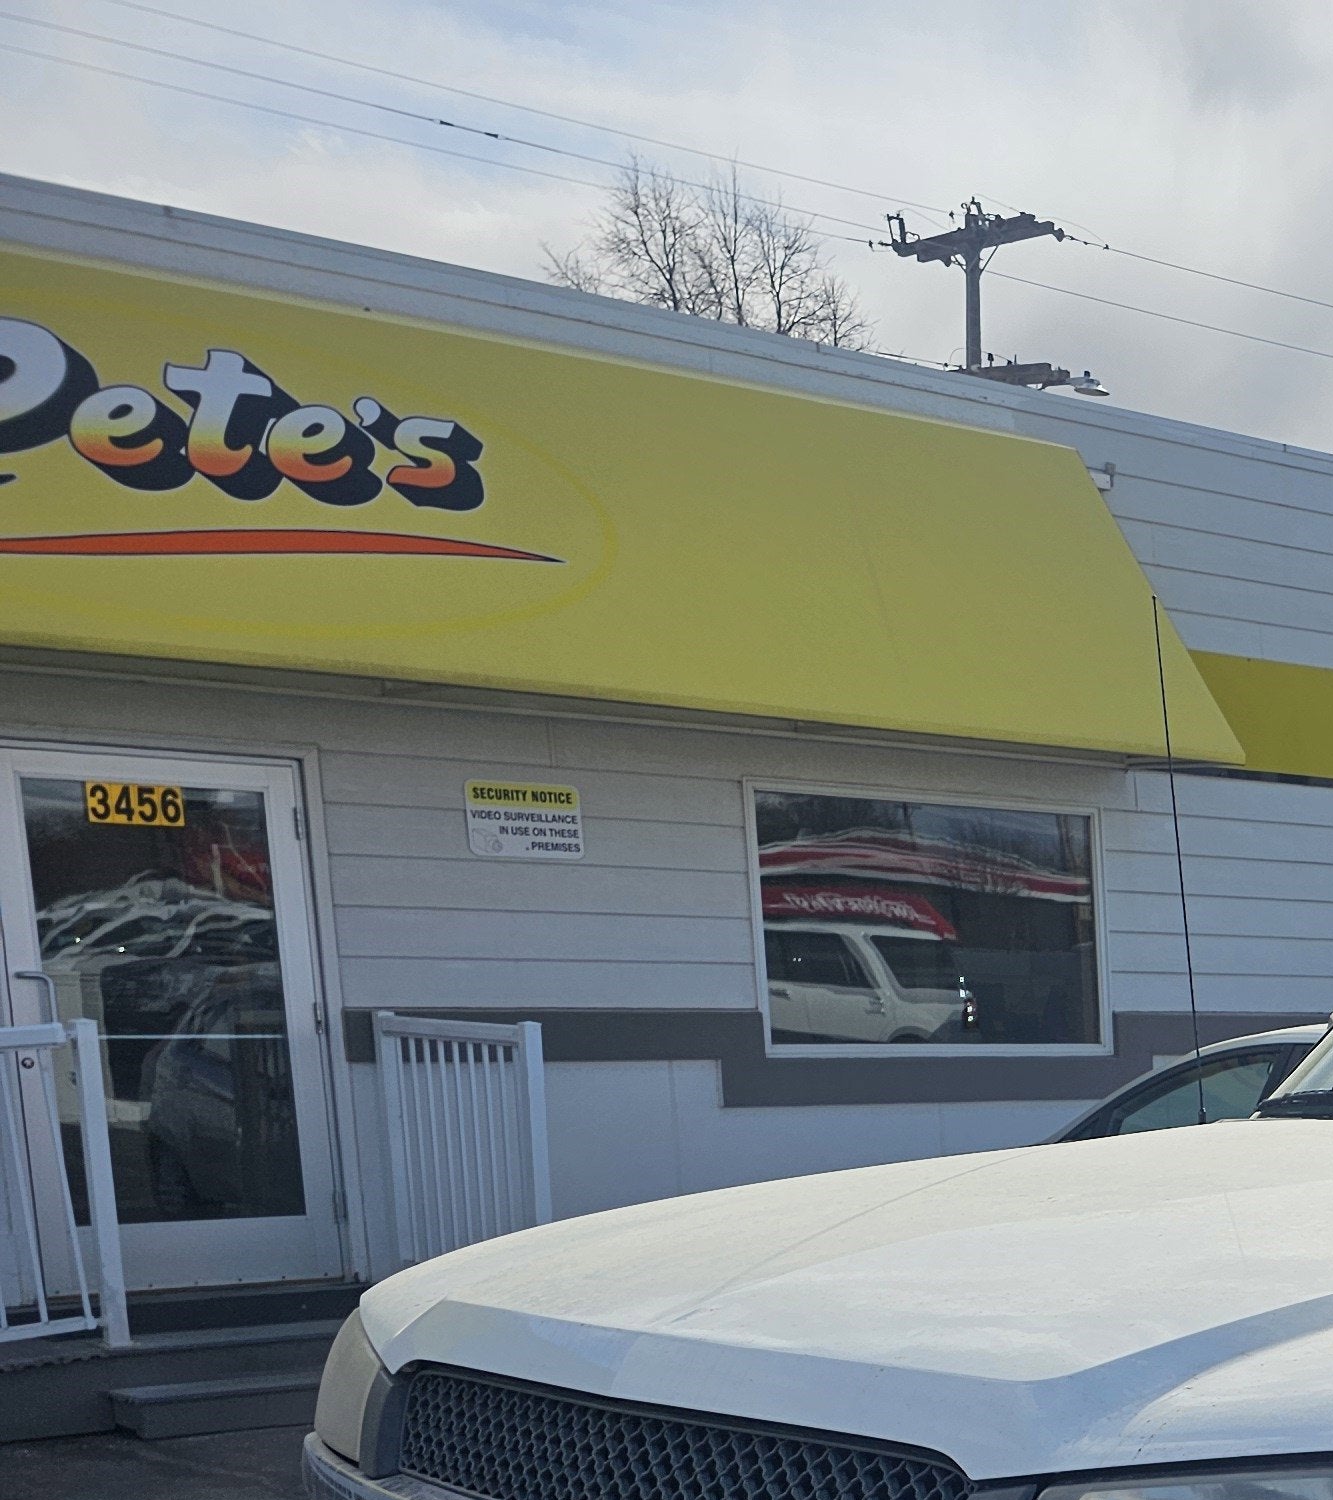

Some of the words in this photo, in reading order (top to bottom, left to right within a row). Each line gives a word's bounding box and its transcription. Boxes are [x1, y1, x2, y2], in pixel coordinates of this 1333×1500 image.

[472, 787, 528, 802] SECURITY
[531, 790, 573, 804] NOTICE
[89, 784, 181, 823] 3456
[470, 809, 501, 820] VIDEO
[503, 811, 578, 824] SURVEILLANCE
[499, 825, 509, 835] IN
[511, 826, 531, 836] USE
[533, 827, 547, 837] ON
[549, 828, 580, 839] THESE
[531, 841, 581, 853] PREMISES
